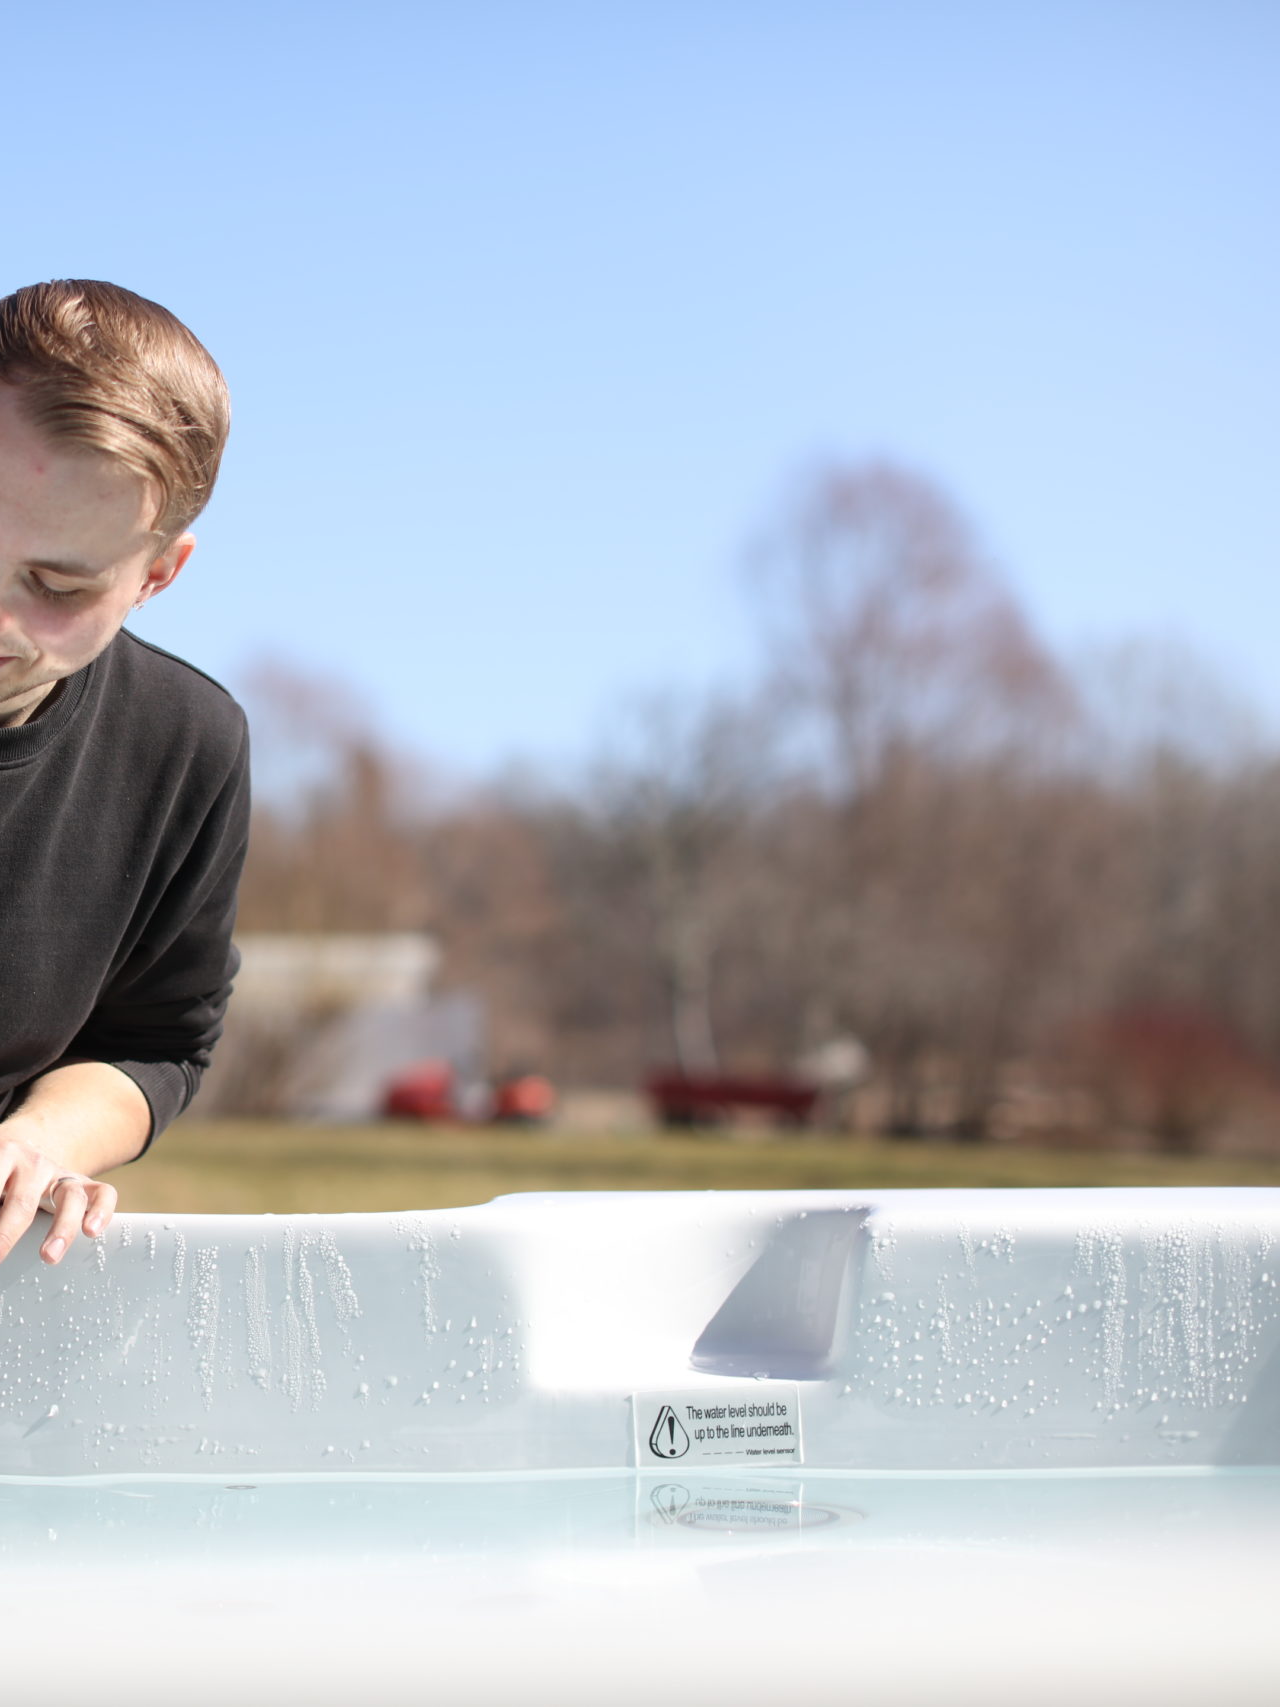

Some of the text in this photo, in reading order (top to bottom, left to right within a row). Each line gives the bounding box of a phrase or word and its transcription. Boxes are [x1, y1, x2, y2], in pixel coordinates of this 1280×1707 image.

[686, 1402, 787, 1420] The water level should be
[694, 1422, 795, 1443] up to the line underneath.
